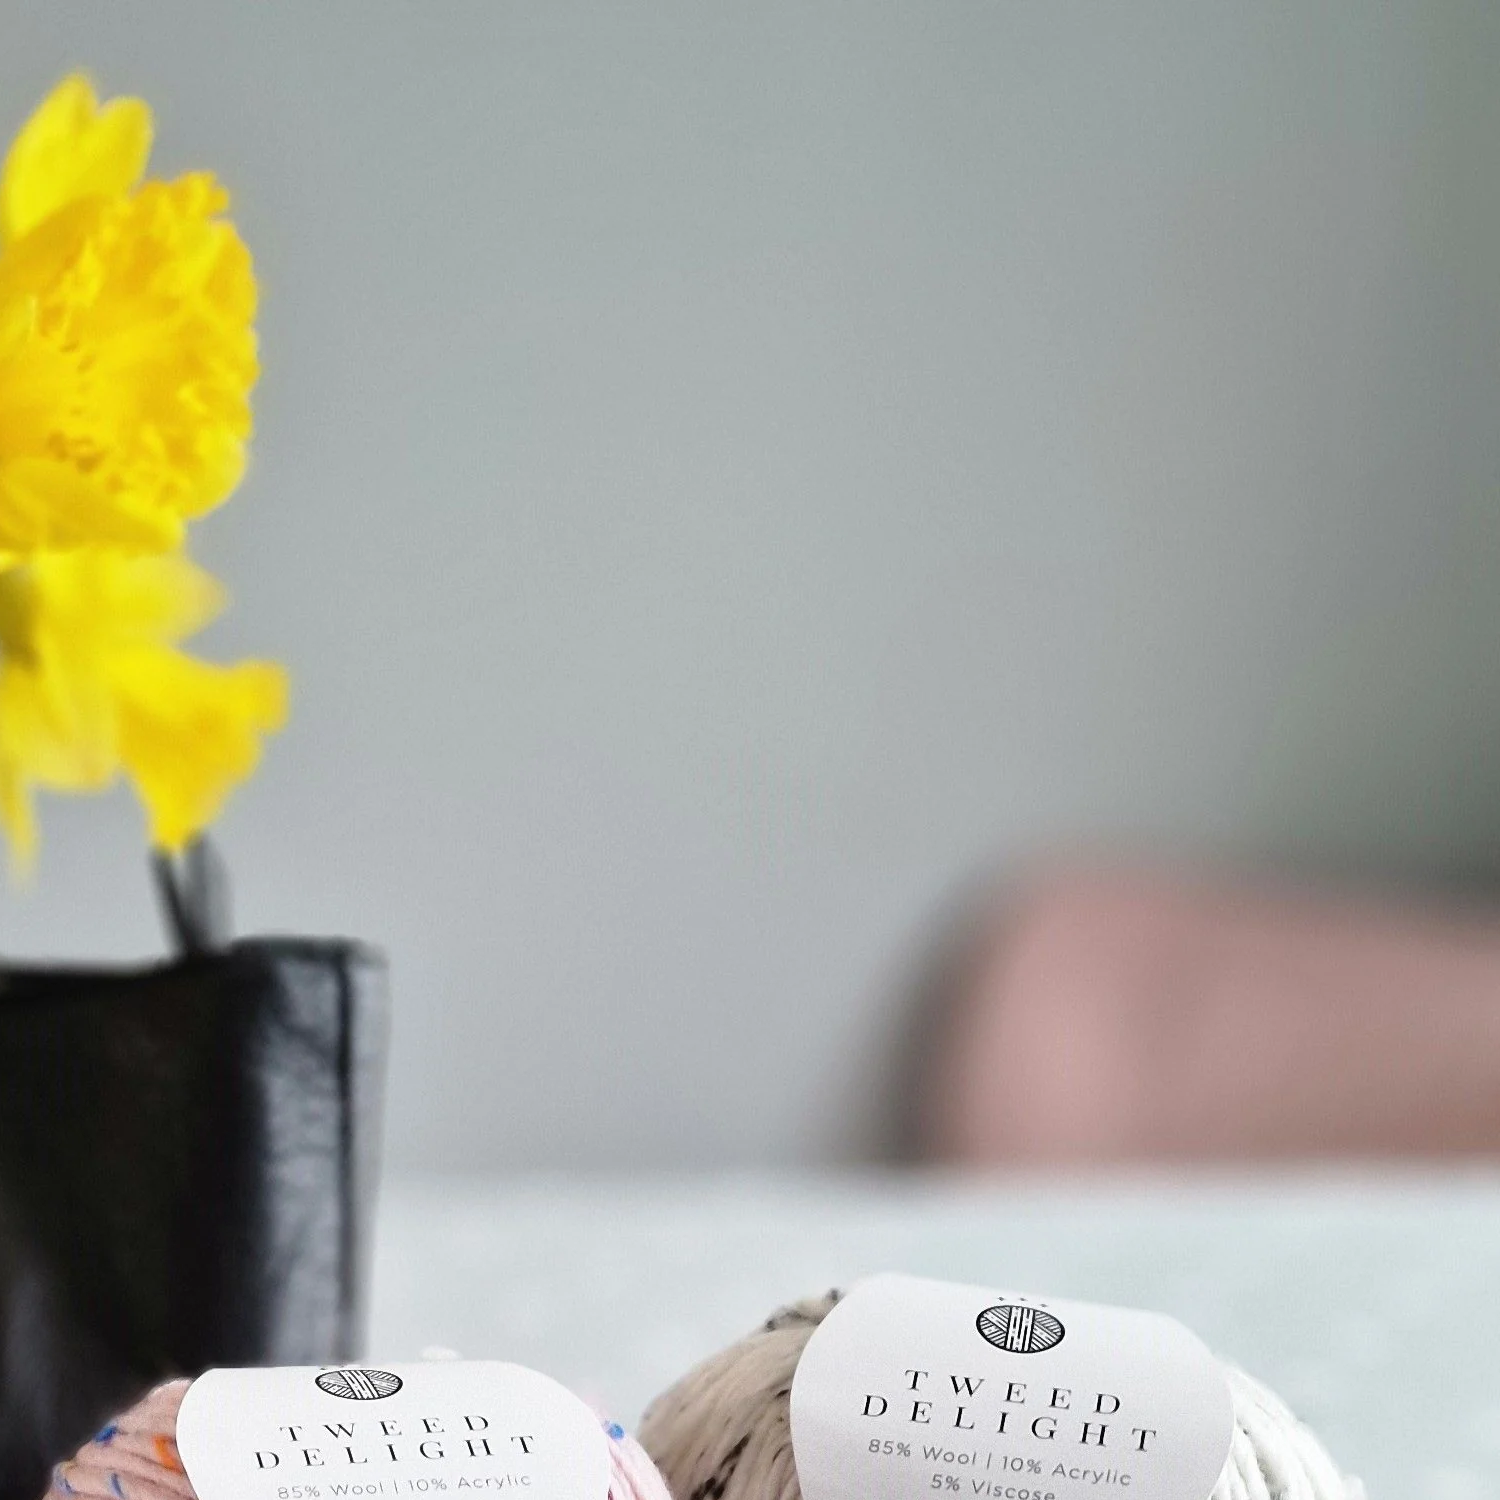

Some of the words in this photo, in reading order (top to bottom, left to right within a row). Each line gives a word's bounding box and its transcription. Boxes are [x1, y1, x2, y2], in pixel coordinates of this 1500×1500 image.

[904, 1369, 1121, 1415] TWEED
[280, 1414, 490, 1442] TWEED
[861, 1395, 1156, 1452] DELIGHT
[255, 1435, 537, 1470] DELIGHT
[868, 1439, 911, 1458] 85%
[922, 1446, 976, 1465] Wool
[1002, 1456, 1041, 1474] 10%
[1052, 1463, 1131, 1487] Acrylic
[278, 1485, 320, 1499] 85%
[329, 1481, 384, 1496] Wool
[409, 1478, 447, 1492] 10%
[458, 1473, 531, 1490] Acrylic
[932, 1474, 960, 1492] 5%
